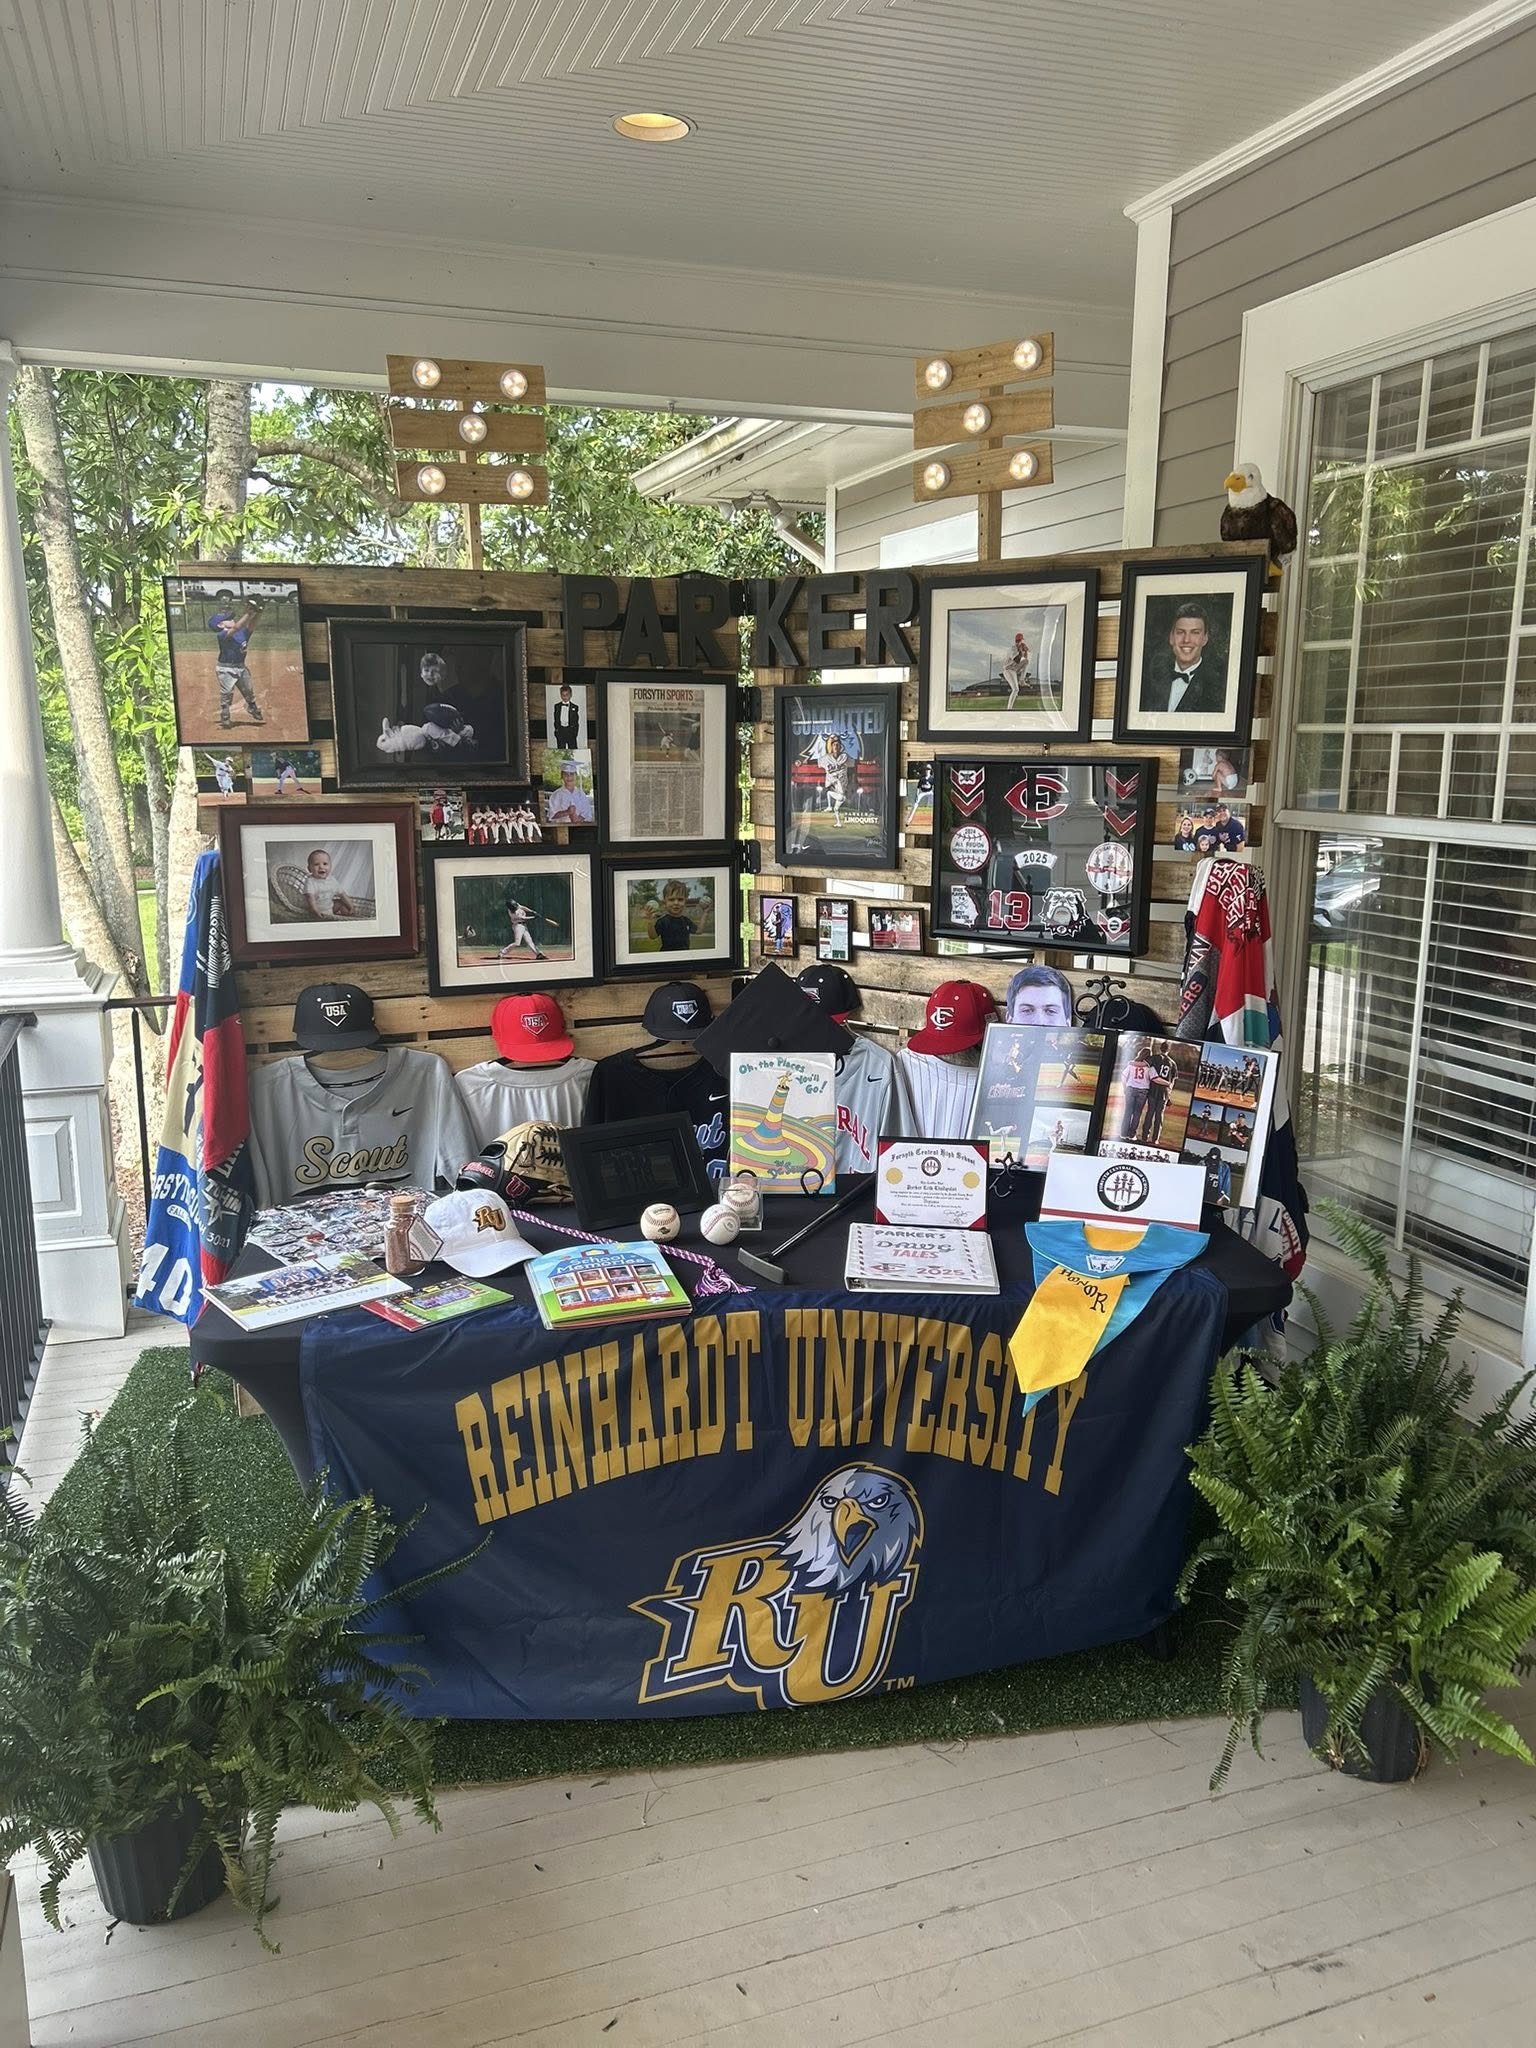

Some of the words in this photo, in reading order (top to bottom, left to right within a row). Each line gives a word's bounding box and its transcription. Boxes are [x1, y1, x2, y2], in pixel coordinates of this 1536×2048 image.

[563, 572, 921, 668] PARKER
[633, 688, 665, 700] FORSYTH
[666, 689, 694, 700] SPORTS
[792, 703, 885, 735] COMMITTED
[843, 816, 879, 825] LINDQUIST
[1023, 854, 1048, 864] 2025
[987, 889, 1031, 931] 13
[325, 1004, 347, 1018] USA
[523, 1015, 544, 1027] USA
[738, 1063, 757, 1075] Oh,
[758, 1060, 775, 1069] the
[776, 1056, 806, 1073] Places
[1133, 1066, 1145, 1080] 13
[1159, 1064, 1170, 1078] 13
[795, 1073, 820, 1084] You'll
[805, 1080, 828, 1094] Go!
[295, 1135, 409, 1185] Scout
[890, 1149, 914, 1162] Forsyth
[915, 1147, 938, 1156] Central
[940, 1148, 955, 1159] High
[956, 1152, 976, 1166] School
[473, 1205, 506, 1232] RU
[874, 1229, 946, 1239] PARKER'S
[569, 1254, 626, 1265] School
[892, 1248, 940, 1259] TALES
[556, 1258, 645, 1275] Memories
[916, 1267, 966, 1276] 2025
[1057, 1268, 1109, 1314] HONOR
[266, 1285, 382, 1317] COOPERSTOWN
[454, 1309, 761, 1527] REINHARDT
[660, 1542, 912, 1708] RU
[882, 1675, 916, 1692] TM
